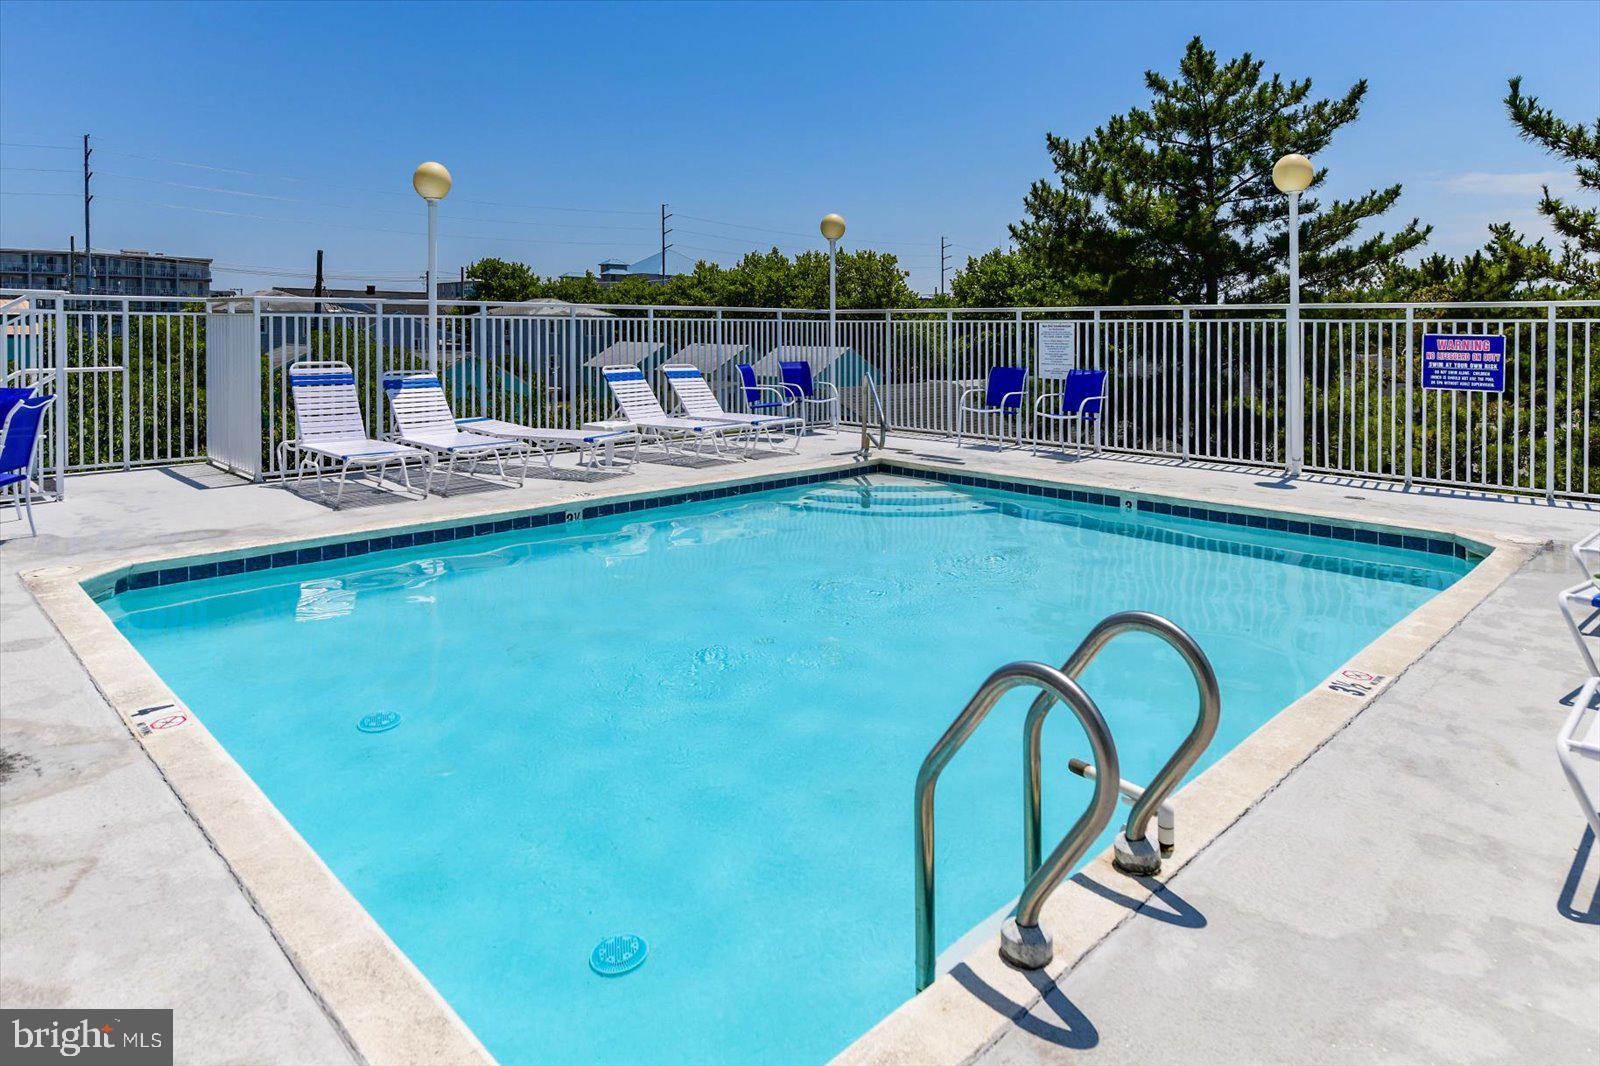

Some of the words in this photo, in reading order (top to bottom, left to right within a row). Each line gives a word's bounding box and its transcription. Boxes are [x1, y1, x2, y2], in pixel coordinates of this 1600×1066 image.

[1436, 339, 1491, 351] WARNING
[1425, 352, 1435, 360] NO
[1436, 352, 1471, 361] LIFEGUARD
[1472, 353, 1481, 361] ON
[1483, 353, 1501, 362] DUTY
